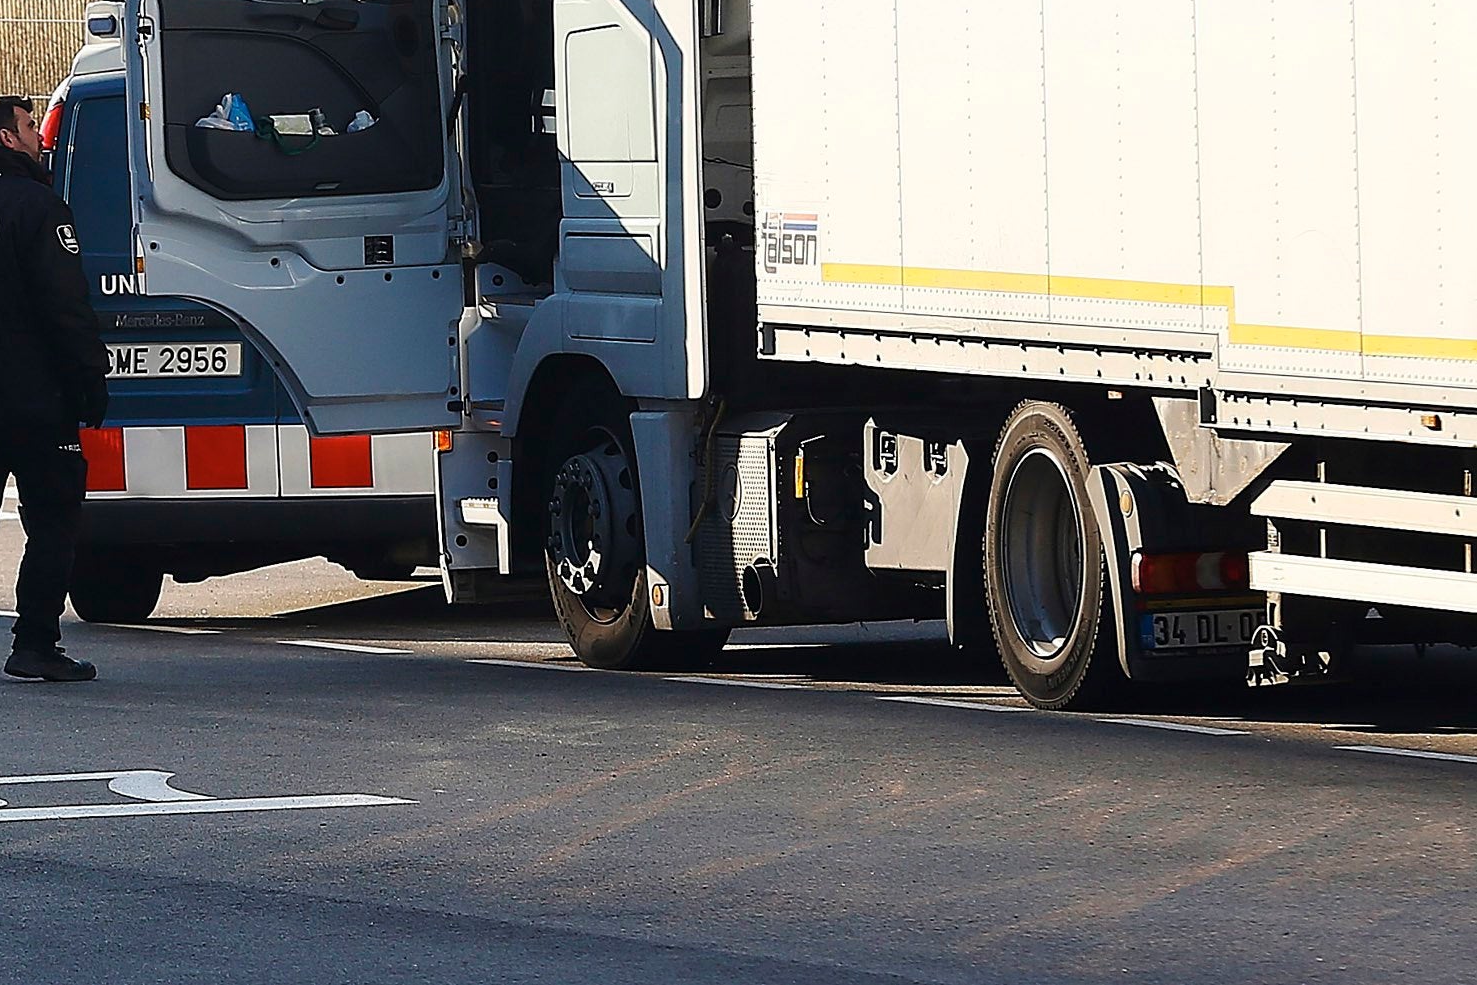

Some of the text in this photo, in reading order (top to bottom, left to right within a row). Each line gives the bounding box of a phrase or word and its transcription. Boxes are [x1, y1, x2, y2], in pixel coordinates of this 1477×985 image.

[159, 347, 228, 373] 2956
[1154, 616, 1186, 645] 34
[1197, 614, 1229, 643] DL
